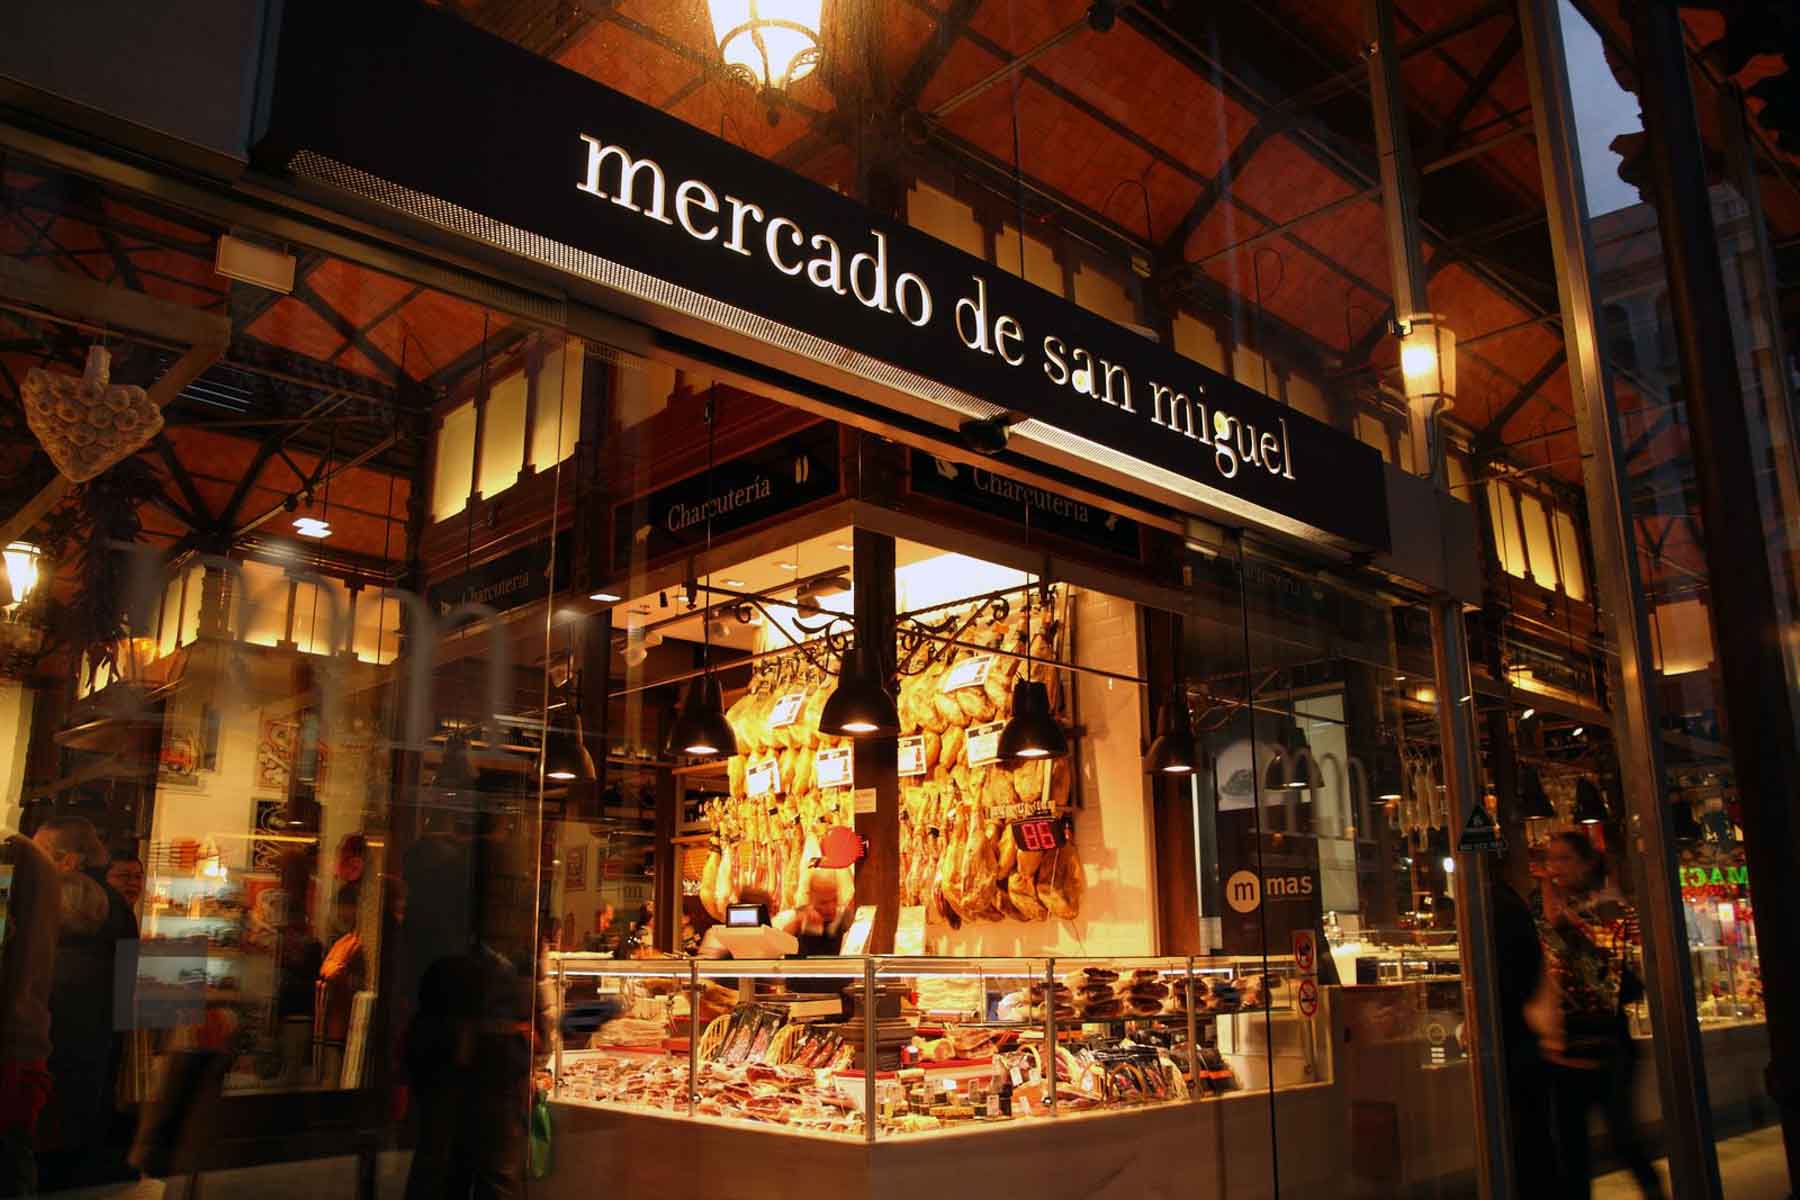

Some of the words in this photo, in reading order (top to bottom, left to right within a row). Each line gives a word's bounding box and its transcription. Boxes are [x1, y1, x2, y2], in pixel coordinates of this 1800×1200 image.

[576, 132, 933, 327] mercado
[955, 275, 1024, 366] de
[1043, 336, 1137, 414] san
[1149, 381, 1296, 480] miguel
[667, 474, 772, 532] Charcutería
[1233, 881, 1255, 901] m
[1265, 875, 1312, 895] mas
